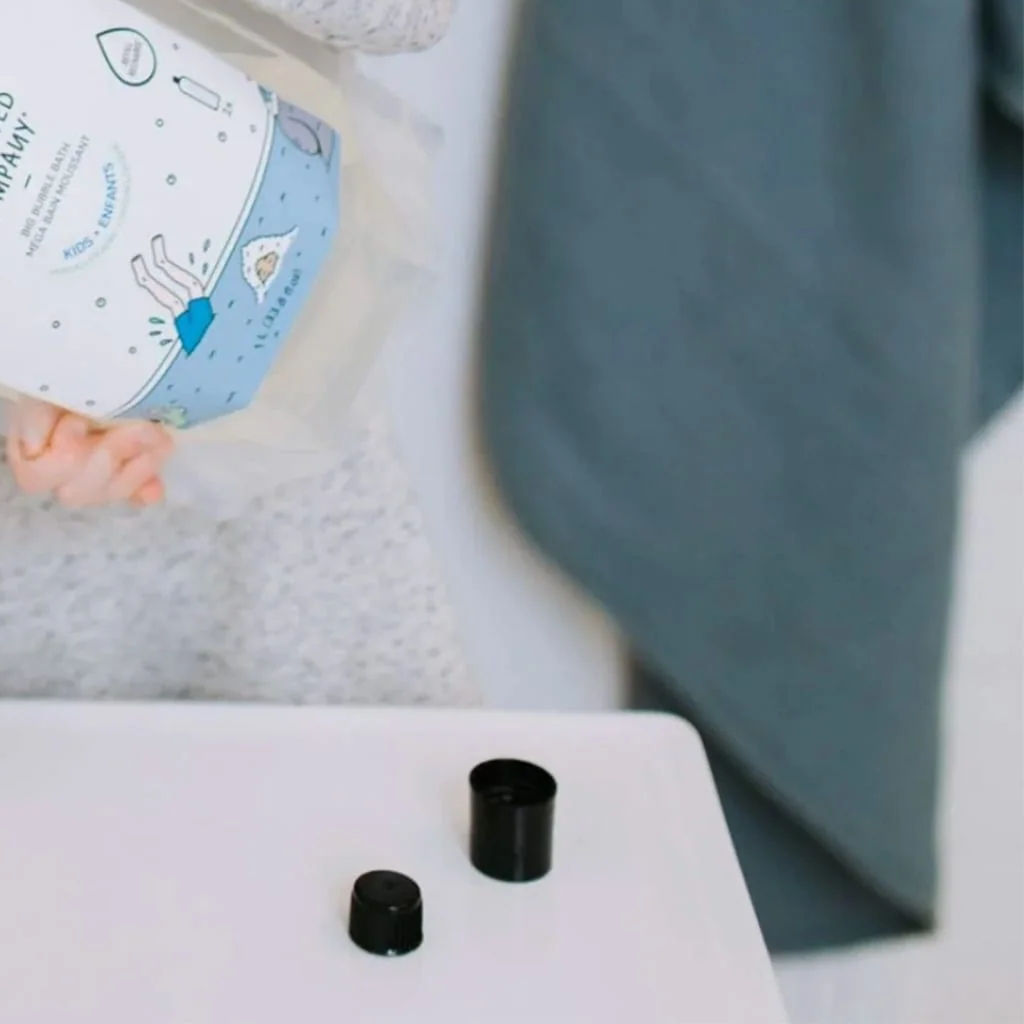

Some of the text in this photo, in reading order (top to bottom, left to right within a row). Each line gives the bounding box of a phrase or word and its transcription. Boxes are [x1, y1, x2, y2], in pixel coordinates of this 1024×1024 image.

[20, 141, 71, 238] BIG BUBBLE BATH
[43, 196, 61, 225] BAIN
[55, 134, 90, 196] MOUSSANT
[62, 161, 117, 260] KIDS ENFANTS
